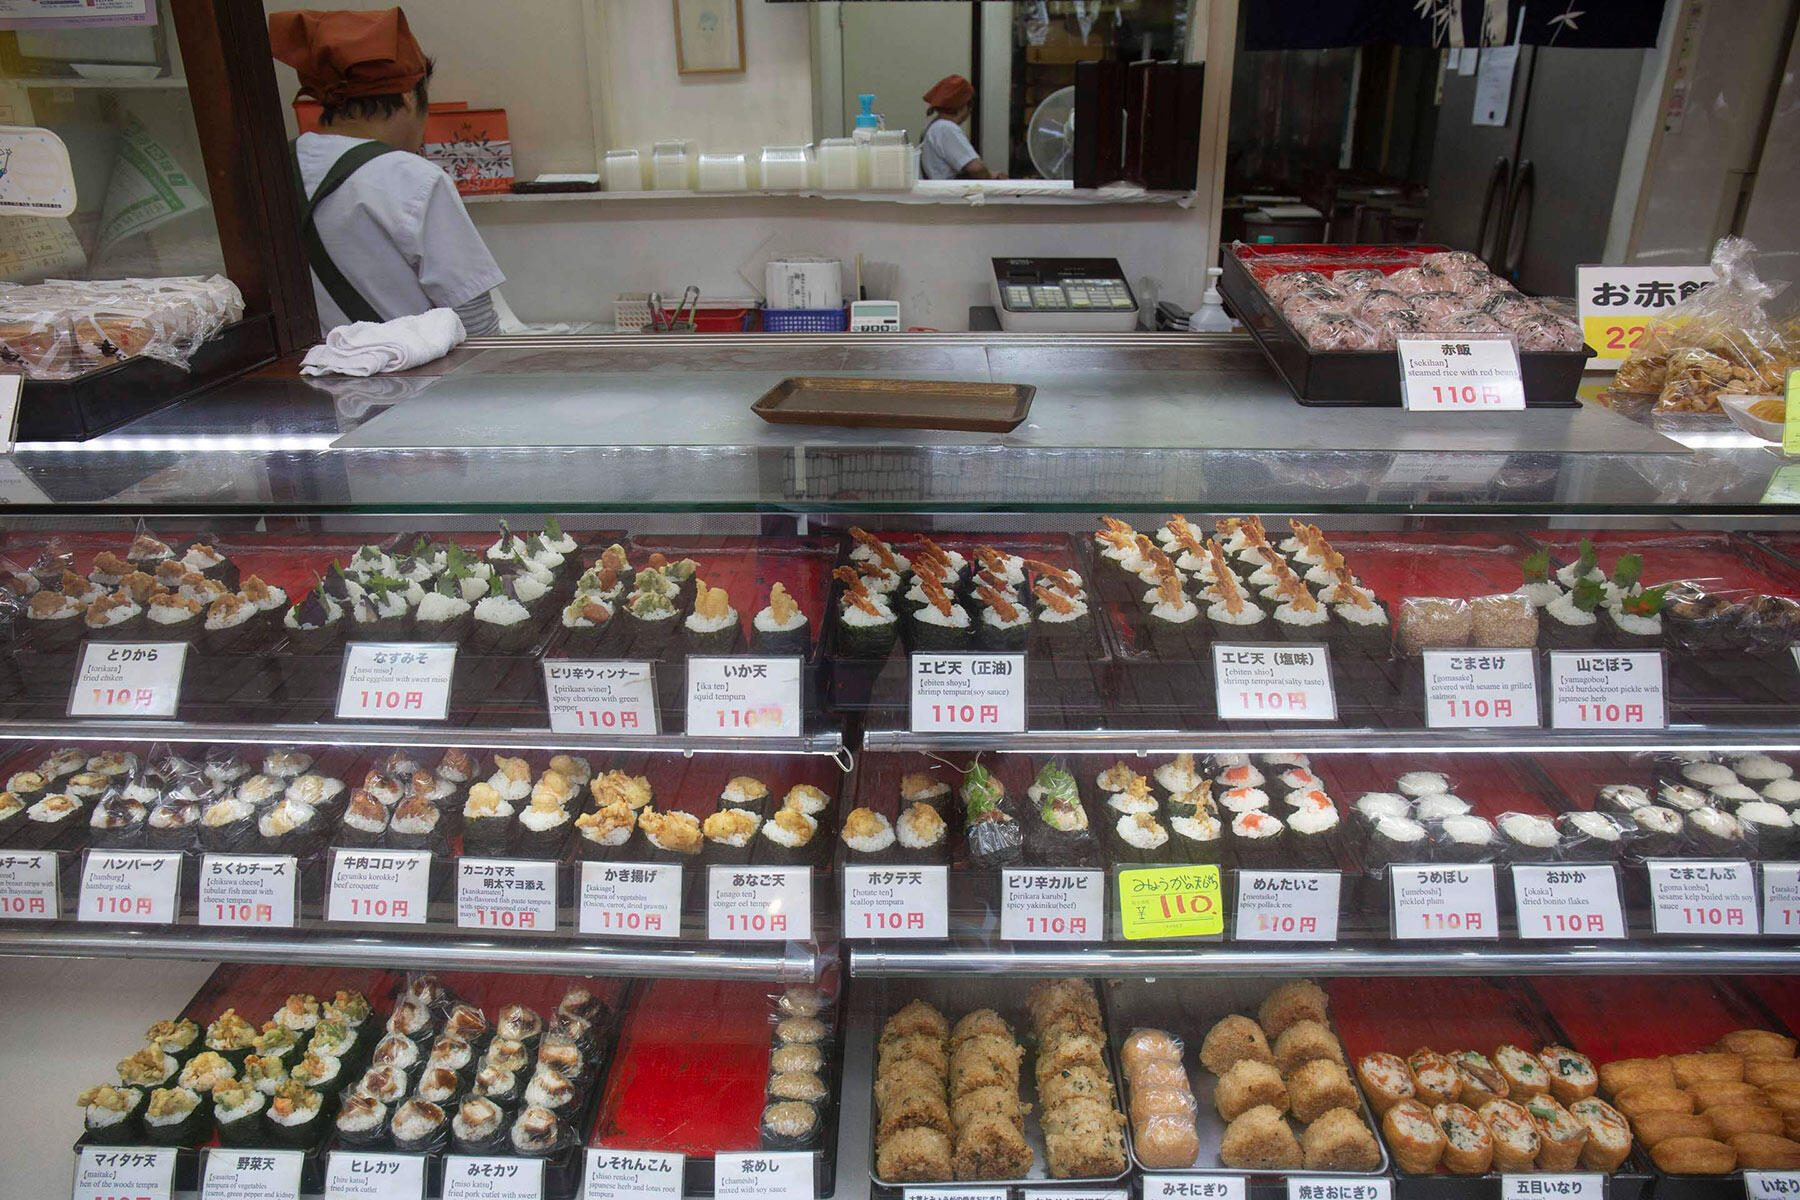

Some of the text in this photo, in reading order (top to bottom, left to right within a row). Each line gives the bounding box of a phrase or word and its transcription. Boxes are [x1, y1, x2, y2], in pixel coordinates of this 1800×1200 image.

[1441, 344, 1472, 356] 赤飯
[1408, 369, 1441, 377] steamed
[1443, 369, 1458, 377] rice
[1461, 368, 1478, 376] with
[1480, 368, 1493, 376] red
[1432, 386, 1501, 404] 110円
[107, 649, 158, 661] とりから
[373, 651, 429, 665] なすみそ
[1450, 656, 1506, 670] ごまさけ
[1576, 657, 1633, 672] 山ごぼう
[83, 674, 99, 682] fried
[551, 668, 640, 679] ピリ辛ウィンナー
[724, 664, 767, 678] いか天
[350, 675, 365, 683] fried
[395, 675, 410, 683] with
[1224, 678, 1250, 686] shrimp
[917, 689, 941, 697] shrimp
[1431, 683, 1458, 691] covered
[1459, 682, 1475, 691] with
[1510, 682, 1533, 691] grilled
[1558, 685, 1574, 693] wild
[1620, 685, 1642, 694] pickle
[1643, 685, 1660, 693] with
[92, 689, 153, 706] 110円
[360, 690, 423, 709] 110円
[552, 695, 571, 703] spicy
[601, 695, 618, 703] with
[693, 693, 746, 702] squid tempura
[1240, 691, 1307, 710] 110円
[932, 704, 998, 723] 110円
[1447, 699, 1512, 718] 110円
[1578, 704, 1643, 723] 110円
[575, 710, 638, 728] 110円
[102, 858, 166, 871] ハンバーグ
[211, 862, 286, 876] ちくわチーズ
[343, 856, 420, 870] 牛肉コロッケ
[463, 864, 516, 877] カニカマ天
[604, 868, 658, 883] かき揚げ
[1417, 870, 1469, 884] うめぼし
[1546, 870, 1587, 884] おかか
[1669, 868, 1737, 880] ごまこんぶ
[333, 881, 349, 889] beef
[483, 878, 546, 891] 明太マヨ添え
[732, 873, 786, 887] あなご天
[868, 871, 922, 885] ホタテ天
[1009, 875, 1089, 890] ピリ辛カルビ
[1253, 878, 1319, 891] めんたいこ
[96, 896, 153, 914] 110円
[351, 899, 409, 917] 110円
[850, 898, 875, 907] scallop
[1399, 897, 1445, 907] pickled plum
[1522, 897, 1590, 905] dried bonito flakes
[216, 904, 272, 922] 110円
[477, 909, 535, 928] 110円
[1683, 908, 1744, 926] 110円
[602, 911, 662, 930] 110円
[726, 914, 787, 931] 110円
[863, 912, 924, 929] 110円
[1026, 917, 1087, 934] 110円
[1422, 912, 1482, 930] 110円
[1542, 914, 1605, 932] 110円
[95, 1153, 157, 1168] マイタケ天
[236, 1156, 276, 1171] 野菜天
[351, 1159, 400, 1174] ヒレカツ
[597, 1155, 672, 1173] しそれんこん
[741, 1159, 779, 1173] 茶めし
[467, 1163, 519, 1178] みそカツ
[1162, 1182, 1228, 1197] みそにぎり
[1299, 1184, 1378, 1200] 焼きおにぎり
[1516, 1180, 1582, 1194] 五目いなり
[1761, 1178, 1800, 1193] いなり
[448, 1190, 464, 1198] fried
[464, 1191, 481, 1199] pork
